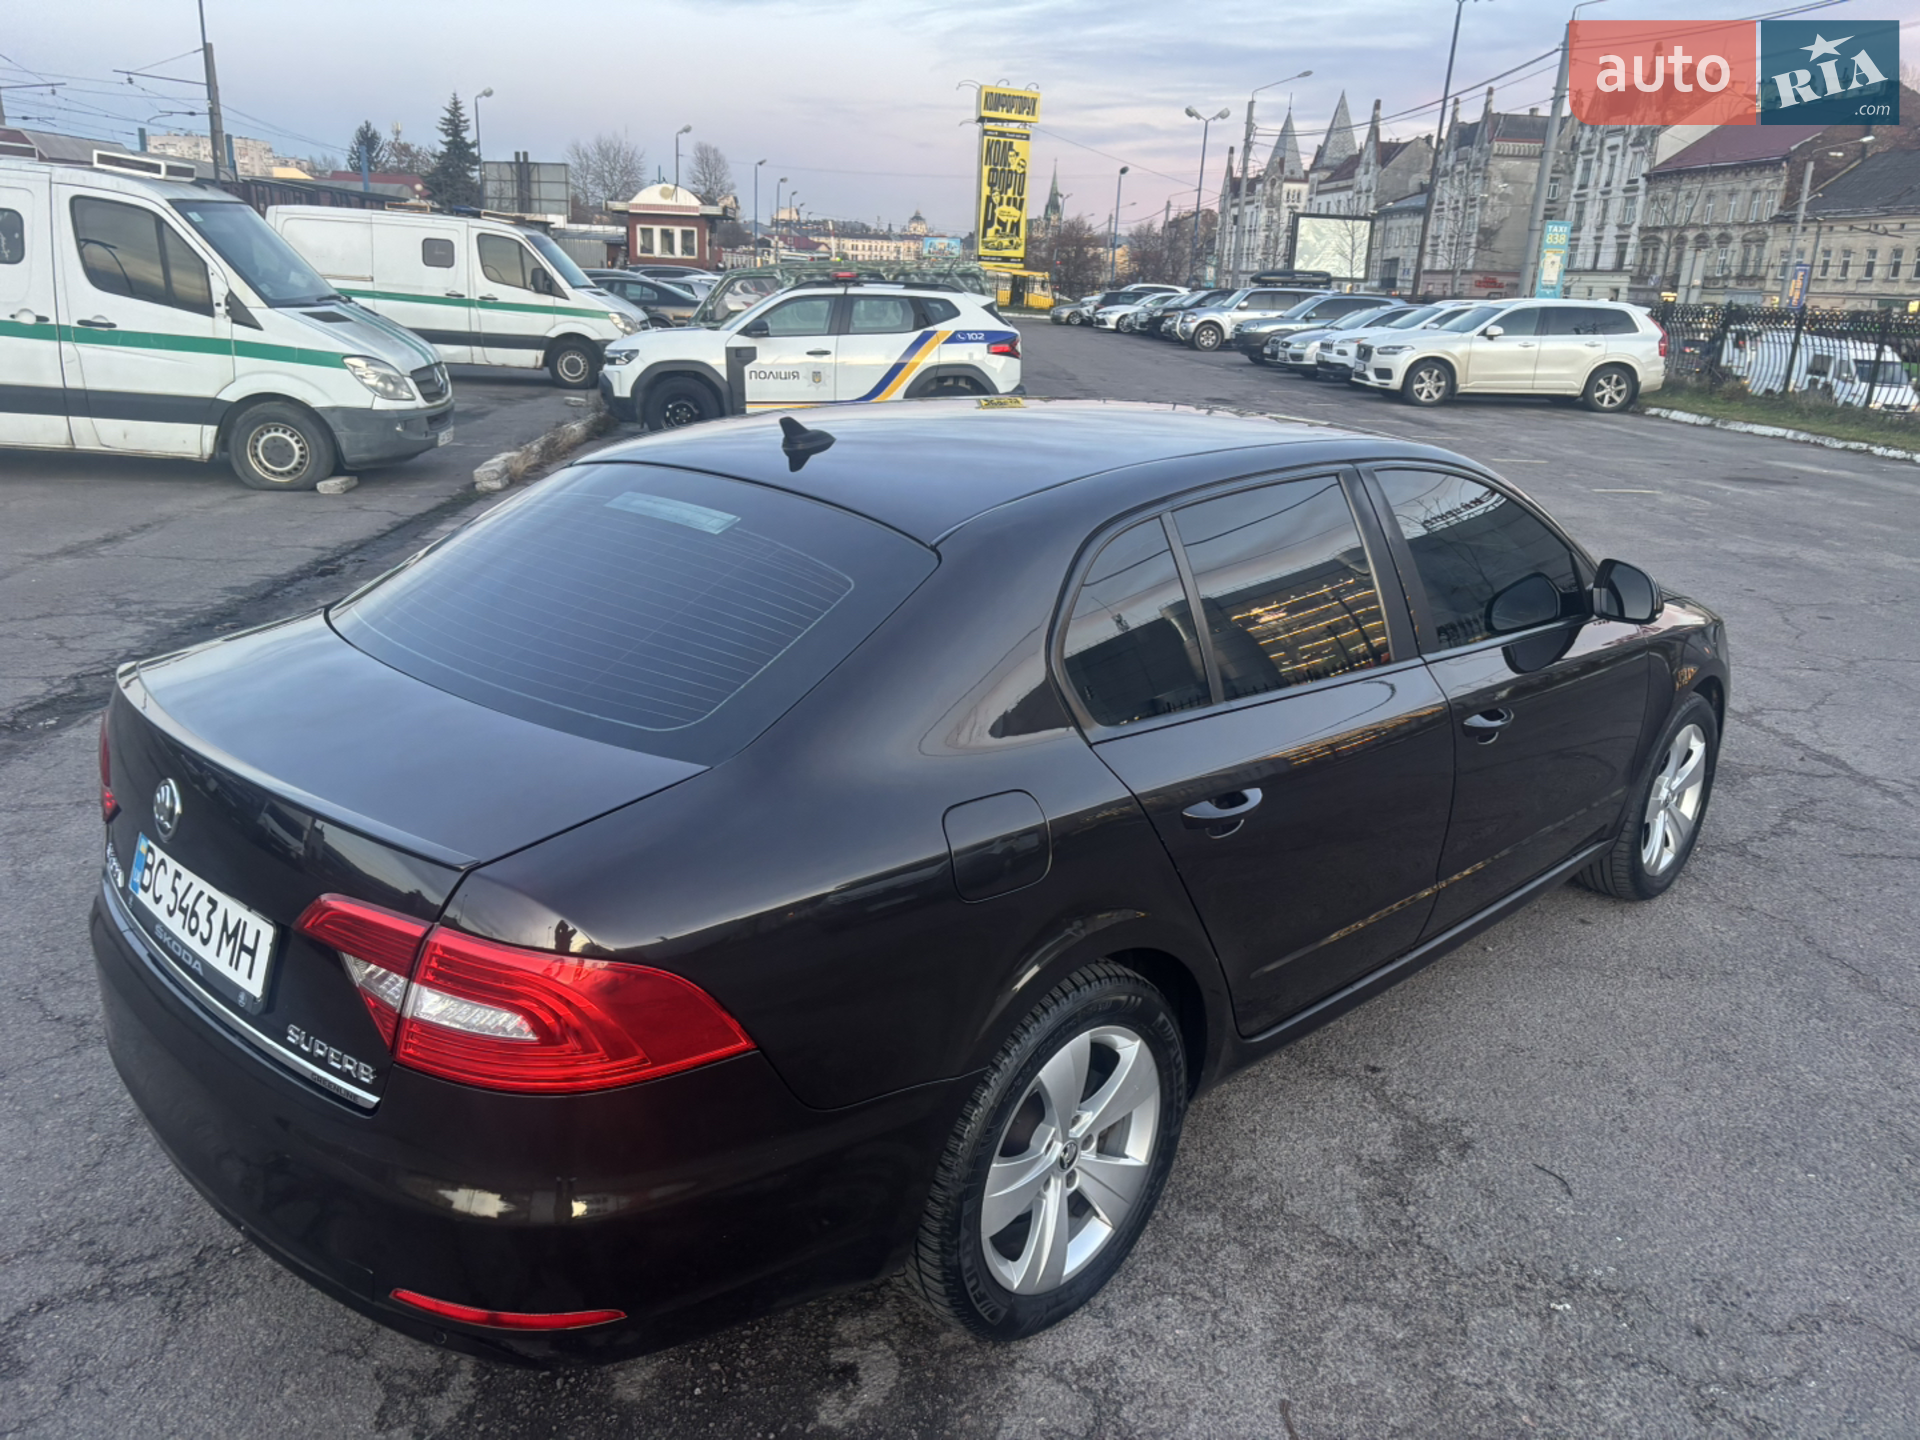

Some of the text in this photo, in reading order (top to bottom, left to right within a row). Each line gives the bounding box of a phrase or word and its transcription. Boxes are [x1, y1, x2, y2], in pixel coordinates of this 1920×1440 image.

[1548, 225, 1567, 233] TAXI
[967, 332, 985, 341] 102
[749, 370, 800, 381] ПОЛІЦІЯ
[140, 848, 168, 906] BC
[166, 868, 218, 946] 5463
[215, 908, 261, 980] MH
[287, 1024, 377, 1084] SUPERB
[310, 1072, 360, 1103] GREENLINE
